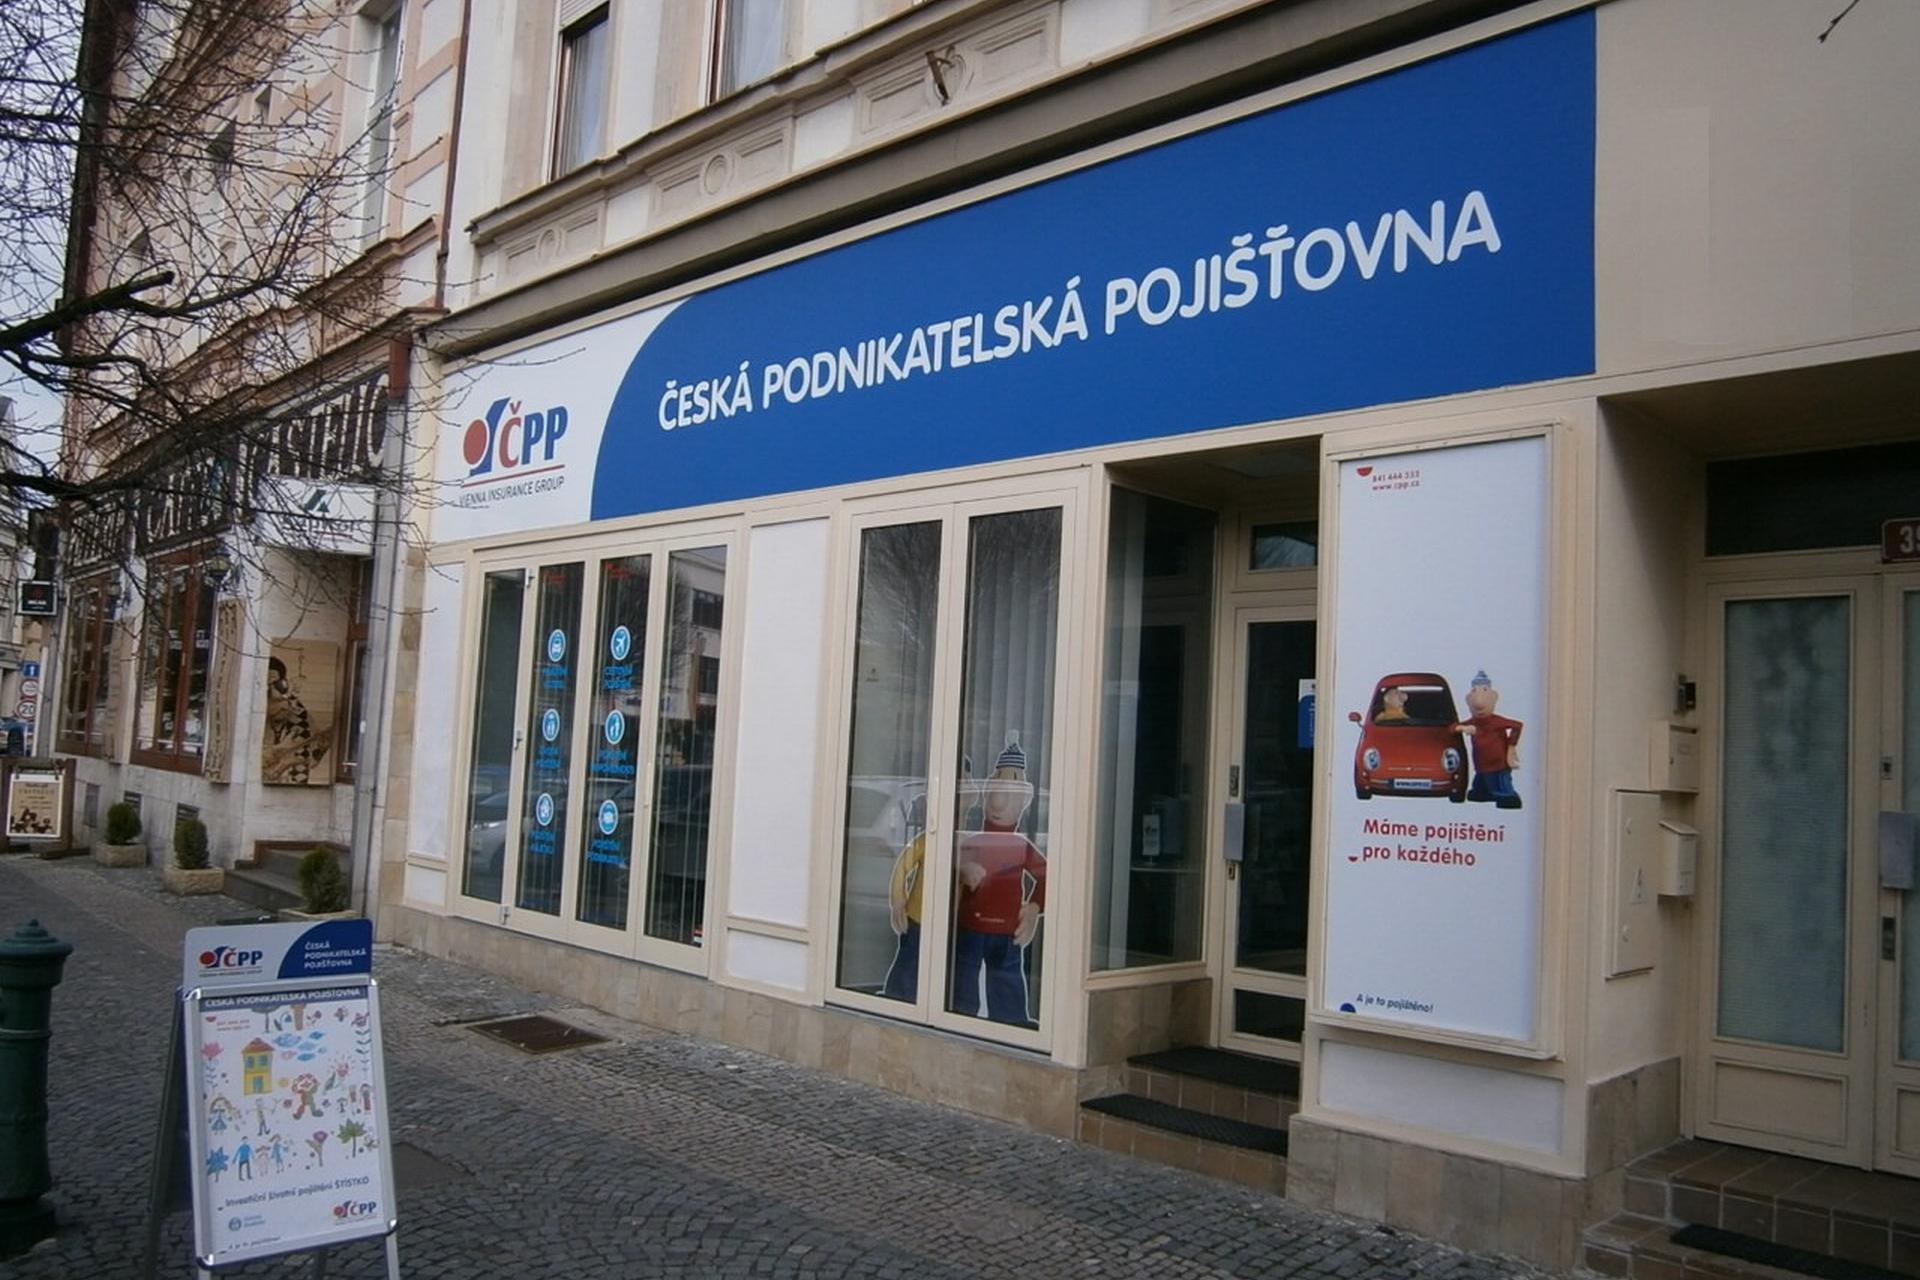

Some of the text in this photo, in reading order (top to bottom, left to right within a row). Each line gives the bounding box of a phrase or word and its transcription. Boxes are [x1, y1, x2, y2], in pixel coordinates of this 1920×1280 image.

[658, 190, 1502, 431] ČESKÁ PODNIKATELSKÁ POJIŠŤOVNA
[498, 400, 569, 468] ČPP
[488, 480, 534, 501] INSURANCE
[534, 475, 565, 493] GROUP
[1363, 818, 1505, 843] Máme pojištění
[1362, 844, 1476, 866] pro každého
[223, 947, 263, 967] ČPP
[304, 941, 330, 951] ČESKÁ
[1356, 993, 1363, 1002] A
[1365, 994, 1374, 1005] je
[1376, 996, 1385, 1006] to
[350, 1200, 377, 1215] ČPP
